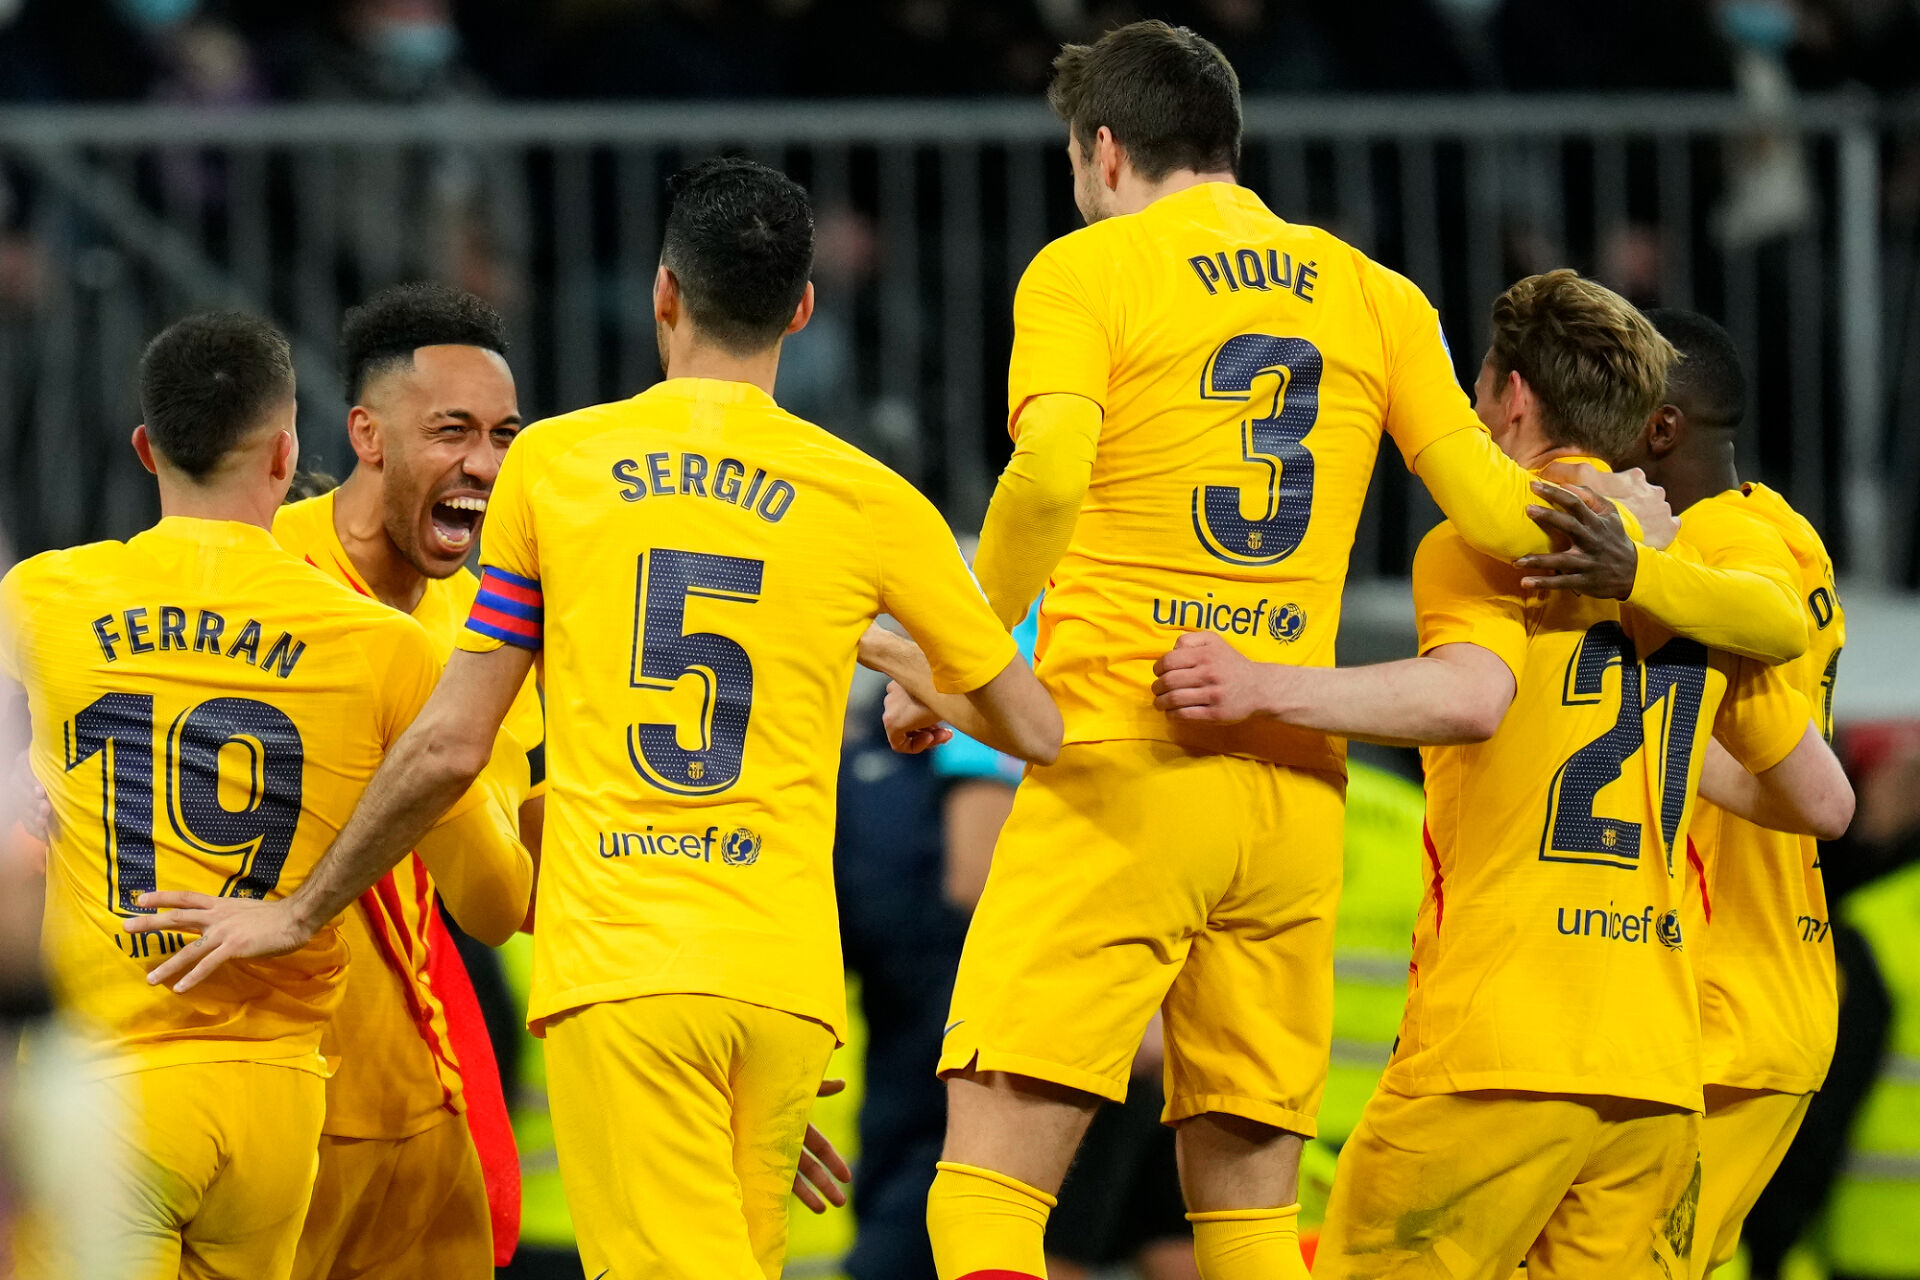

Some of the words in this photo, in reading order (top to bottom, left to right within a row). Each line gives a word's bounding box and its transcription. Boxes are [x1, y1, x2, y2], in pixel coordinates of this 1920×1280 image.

[1189, 250, 1317, 303] PIQUÉ
[1192, 334, 1323, 566] 3
[612, 453, 795, 522] SERGIO
[92, 607, 306, 678] FERRAN
[1154, 593, 1267, 636] unicef
[627, 548, 764, 796] 5
[64, 692, 304, 918] 19
[600, 826, 718, 862] unicef
[115, 930, 185, 958] uni
[1558, 901, 1653, 943] unicef
